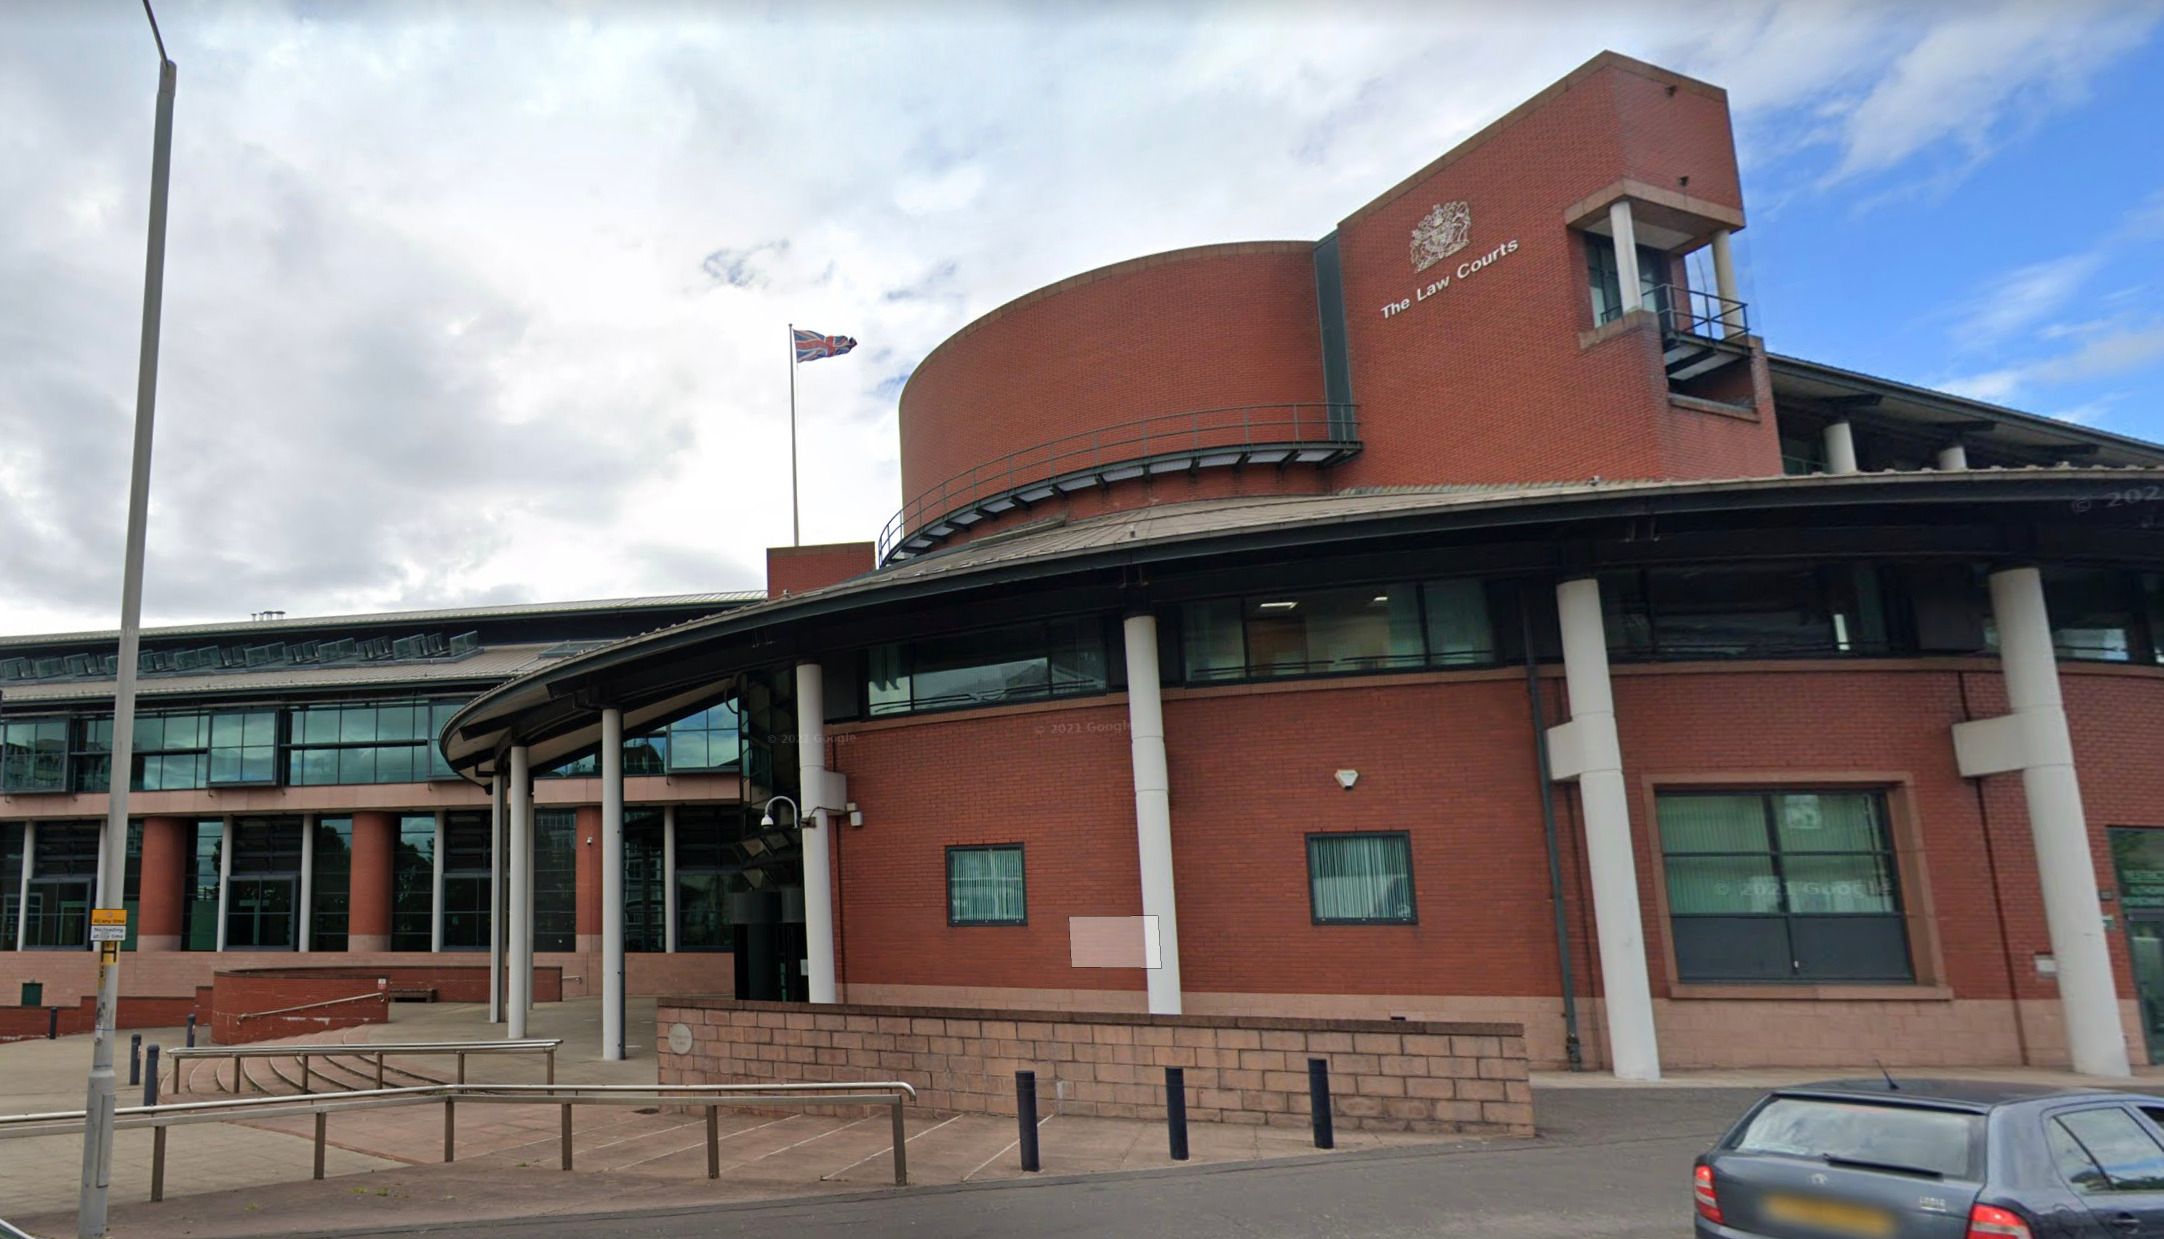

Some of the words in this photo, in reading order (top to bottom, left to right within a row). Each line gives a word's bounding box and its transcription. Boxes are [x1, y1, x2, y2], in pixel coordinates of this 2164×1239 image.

[1381, 297, 1410, 319] The
[1416, 276, 1450, 301] Law
[1456, 239, 1519, 279] Courts
